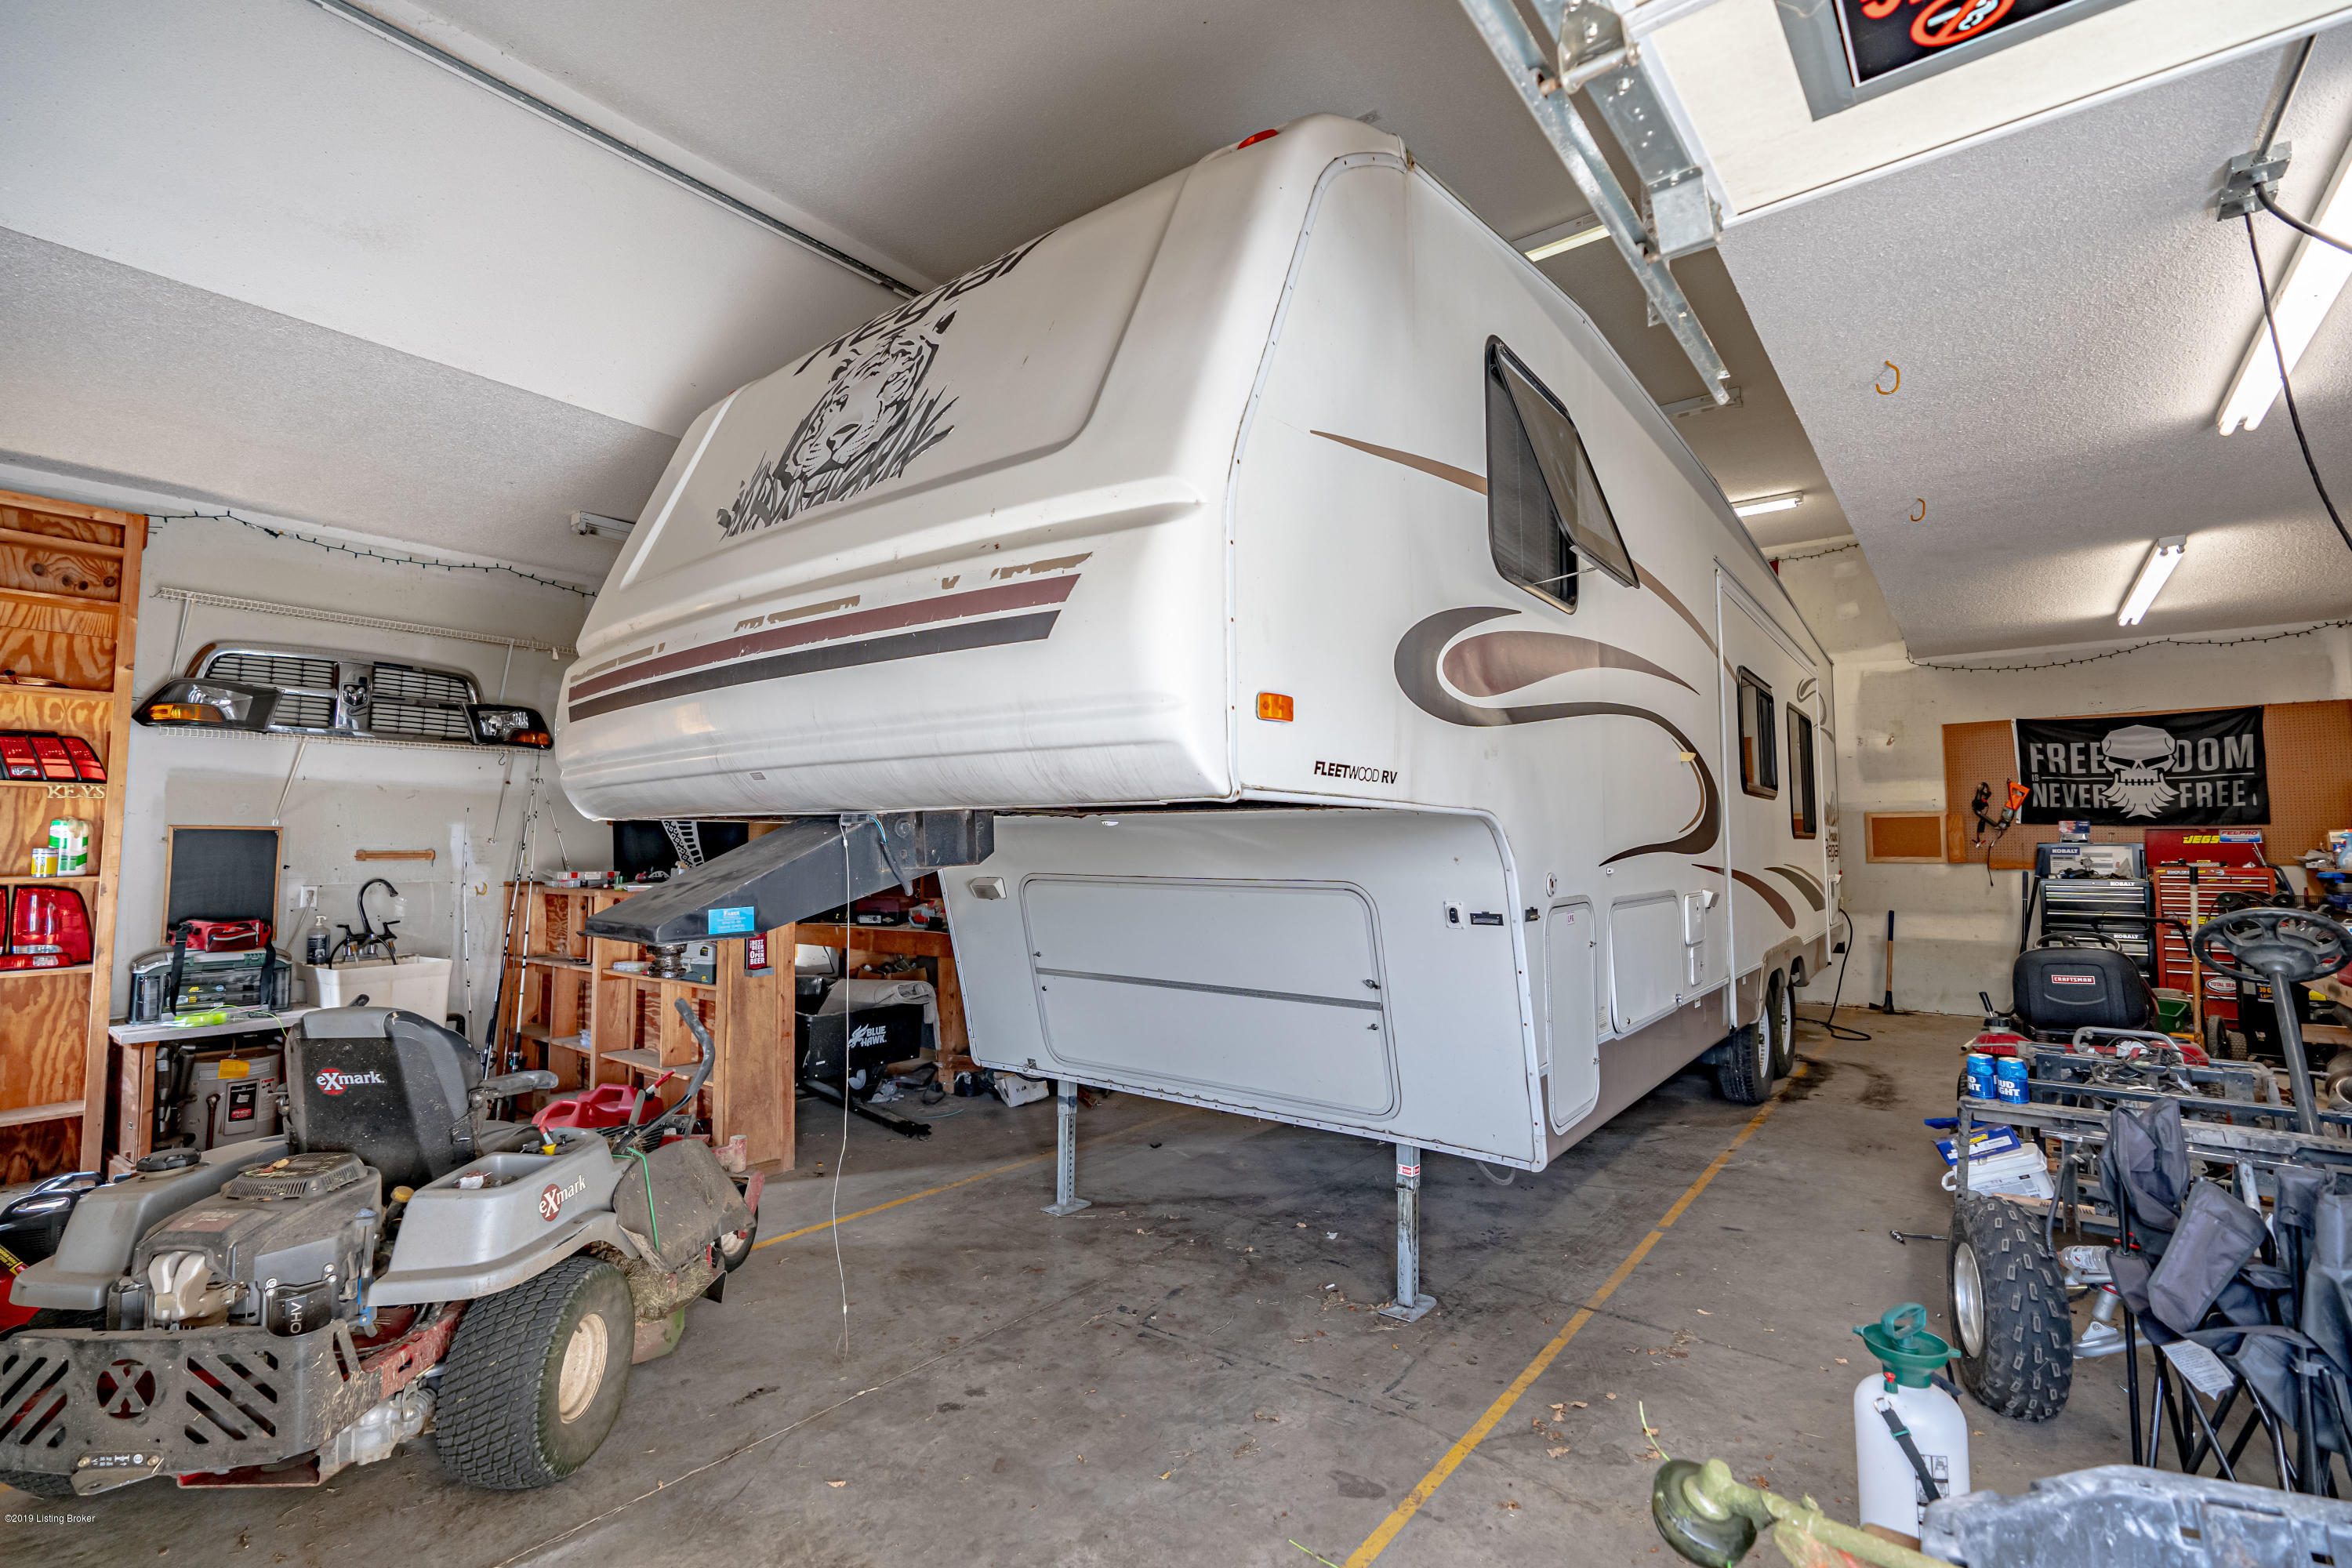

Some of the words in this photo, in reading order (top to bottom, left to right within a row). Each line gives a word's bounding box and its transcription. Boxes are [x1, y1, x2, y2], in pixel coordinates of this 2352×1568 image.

[1314, 760, 1379, 782] FLEETWOOD
[1381, 770, 1398, 784] RV
[47, 785, 107, 799] KEYS
[2032, 782, 2109, 809] NEVER
[2180, 780, 2246, 808] FREE
[2183, 835, 2220, 844] JEGS
[866, 1025, 887, 1037] BLUE
[290, 1301, 303, 1334] OHV
